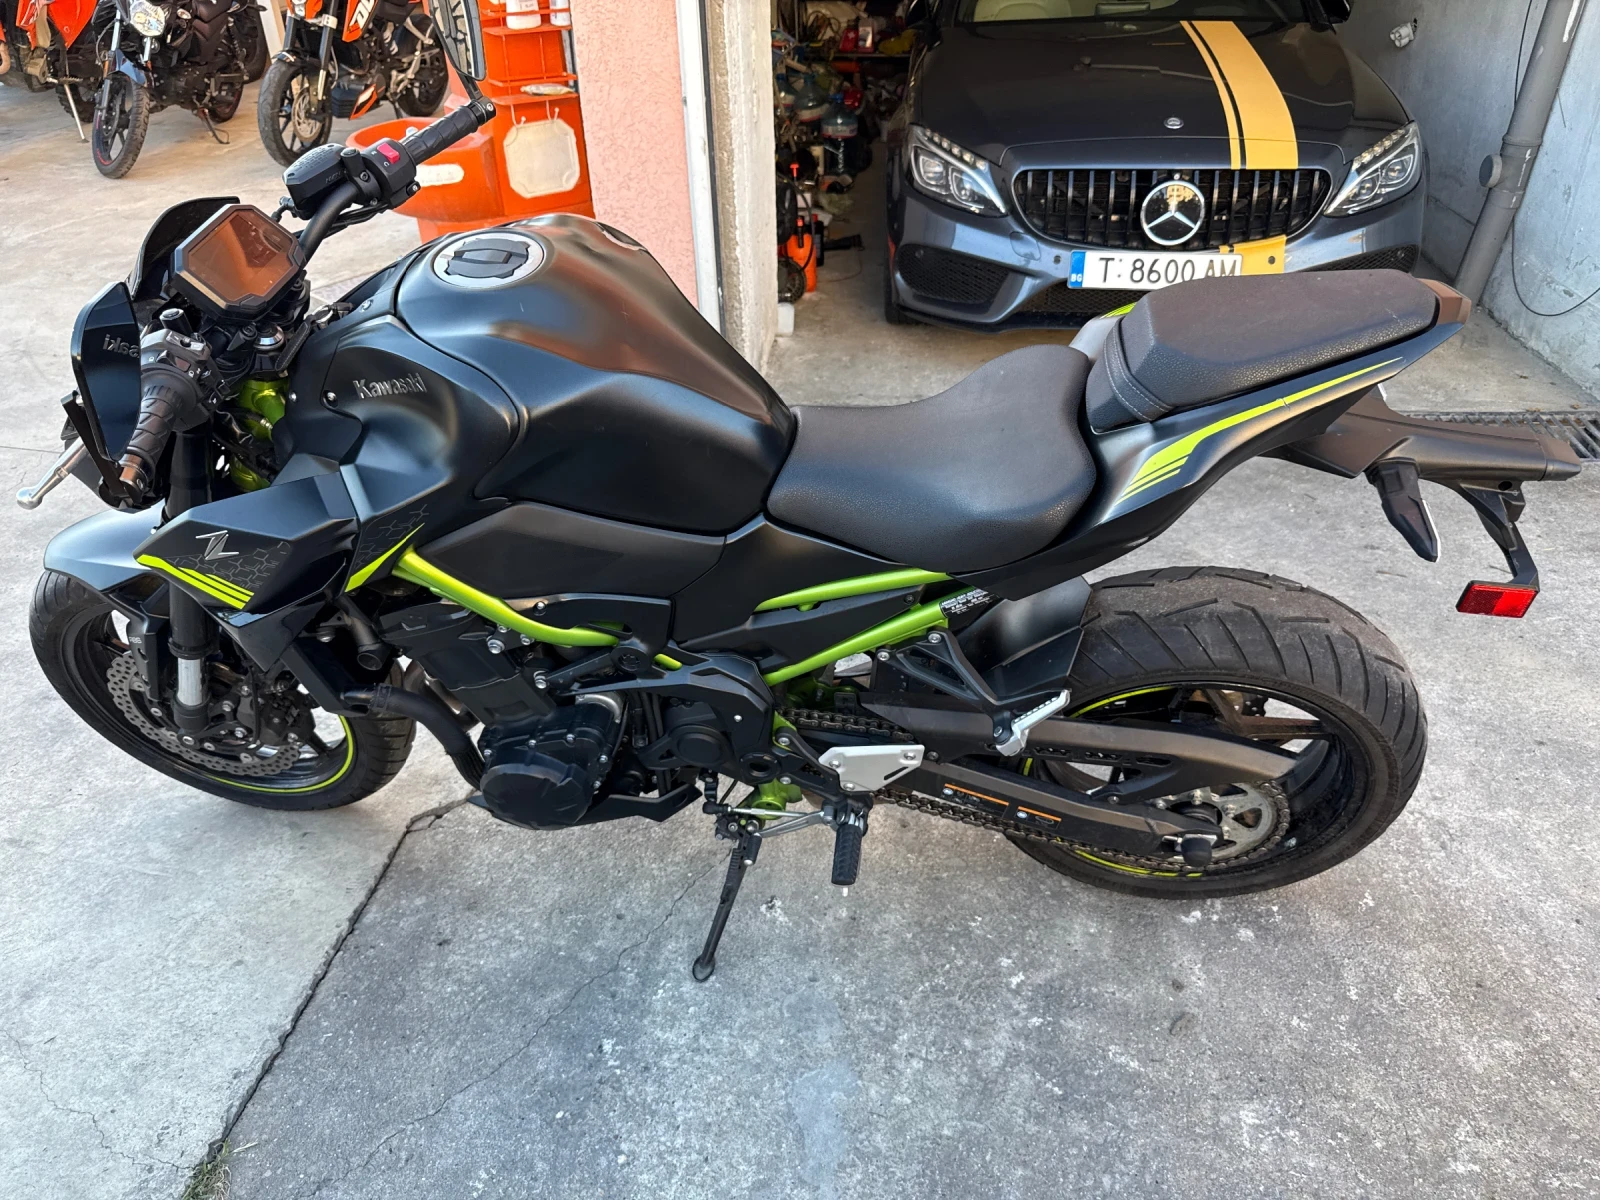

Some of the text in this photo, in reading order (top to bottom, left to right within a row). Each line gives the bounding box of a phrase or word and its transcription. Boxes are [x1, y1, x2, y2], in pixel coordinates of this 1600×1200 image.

[1070, 273, 1083, 283] BG
[1130, 257, 1196, 285] 8600
[1203, 258, 1237, 278] AM
[352, 372, 428, 400] Kawasaki
